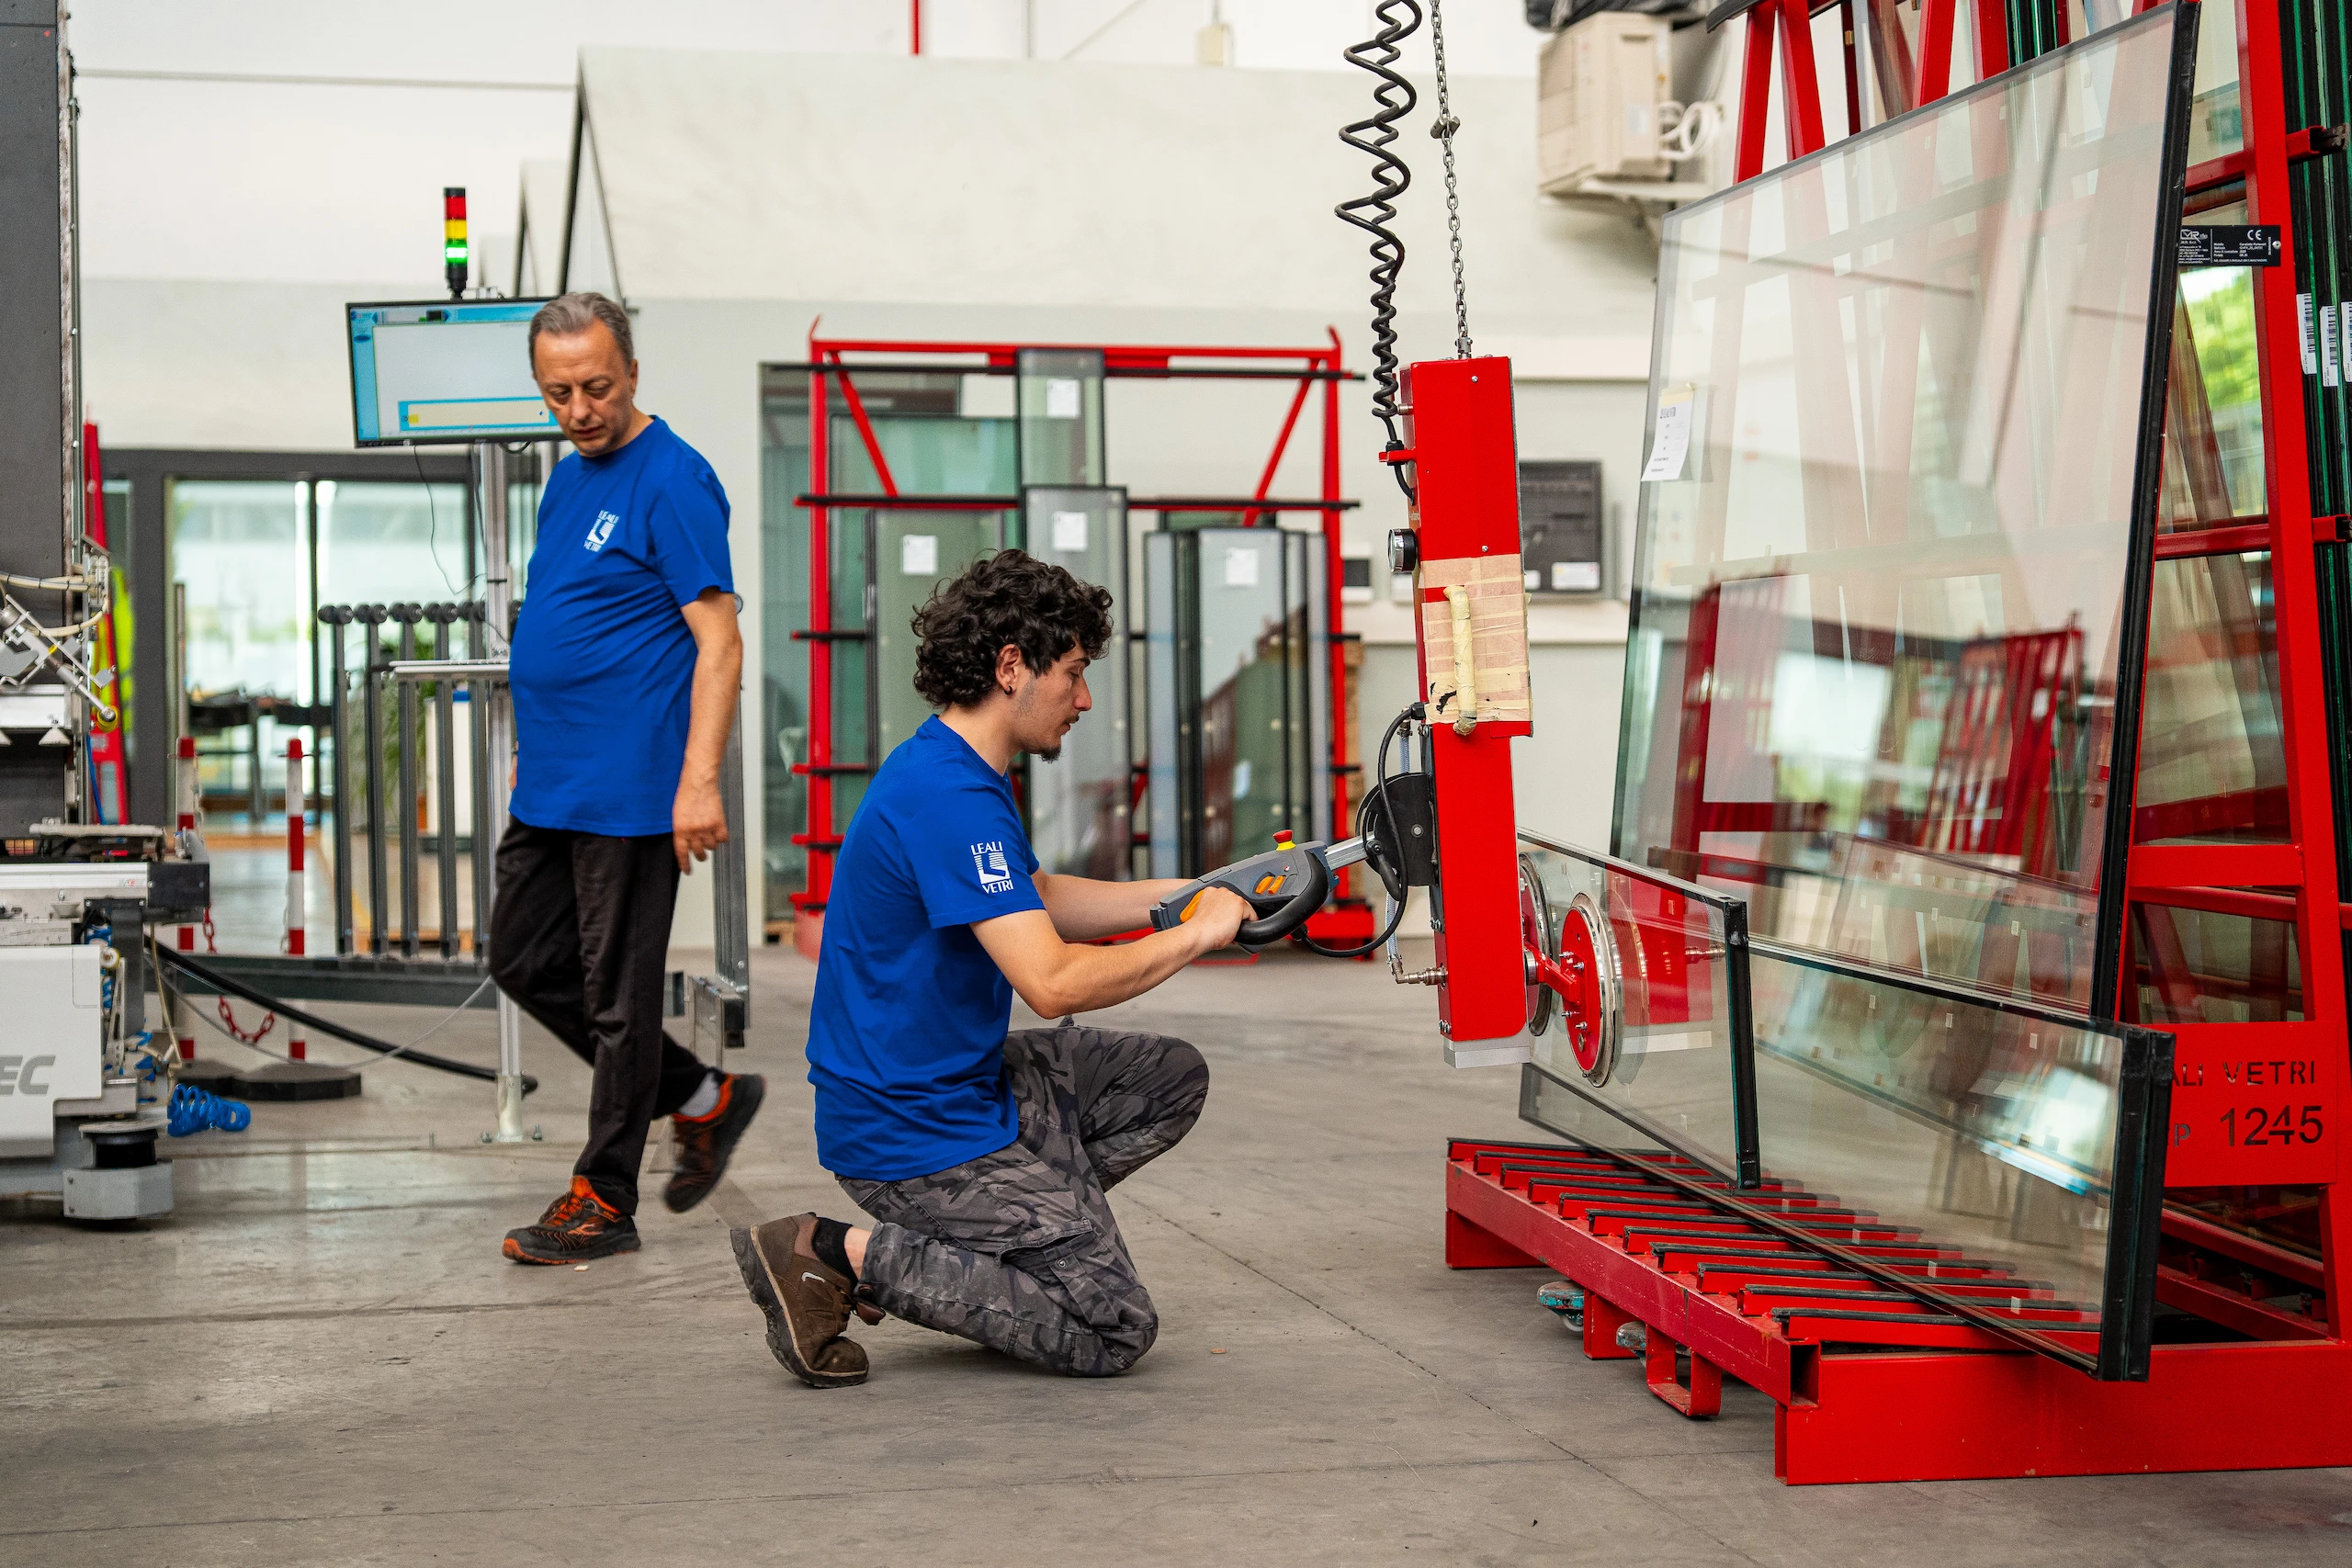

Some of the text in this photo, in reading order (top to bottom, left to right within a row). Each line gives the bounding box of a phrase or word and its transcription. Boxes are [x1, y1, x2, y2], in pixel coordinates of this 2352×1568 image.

[2247, 229, 2262, 241] CE
[970, 840, 1003, 856] LEALI
[982, 879, 1014, 894] VETRI
[2222, 1060, 2315, 1086] VETRI
[2220, 1104, 2324, 1147] 1245
